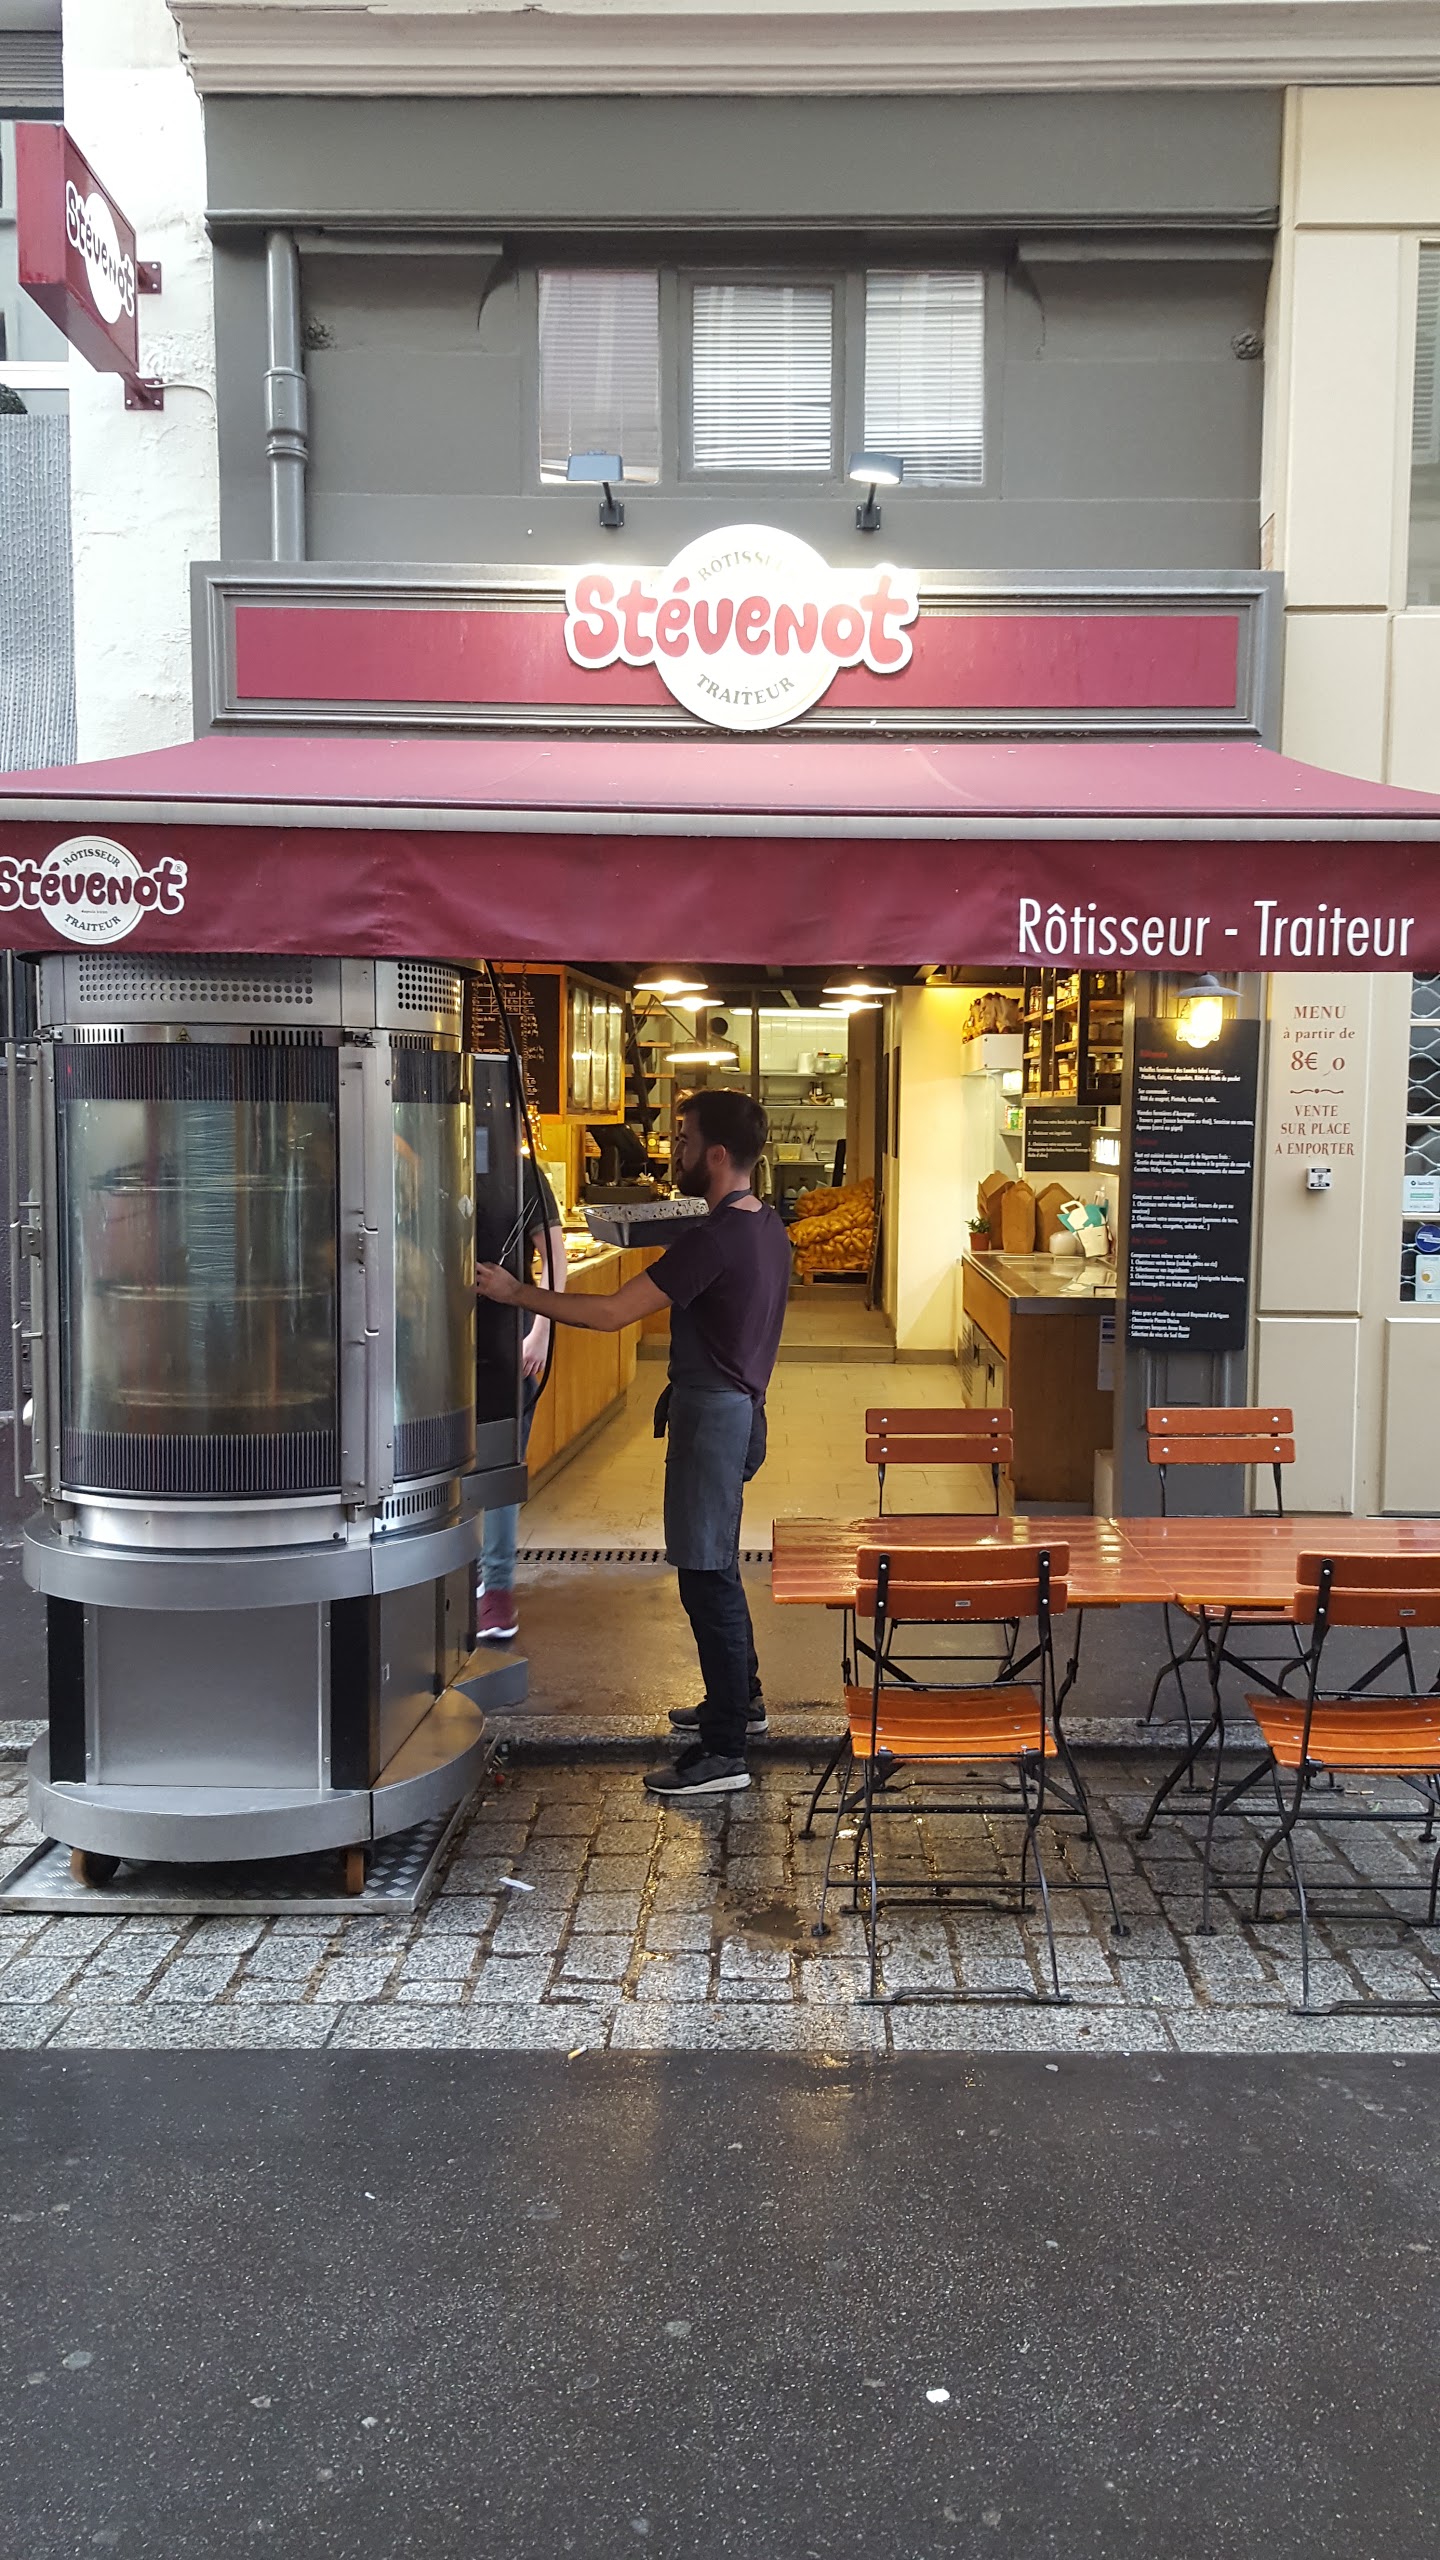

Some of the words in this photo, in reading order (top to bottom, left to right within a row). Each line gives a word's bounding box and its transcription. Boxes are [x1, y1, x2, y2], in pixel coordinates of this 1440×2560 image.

[68, 185, 134, 312] Stévenot
[573, 575, 910, 664] Stévenot
[696, 673, 796, 706] TRAITEUR
[62, 848, 121, 868] RÔTISSEUR
[0, 860, 184, 911] Stévenot
[64, 914, 121, 932] TRAITEUR
[1018, 898, 1210, 957] Rôtisseur
[1253, 900, 1415, 957] Traiteur
[1294, 1006, 1346, 1019] MENU
[1283, 1027, 1290, 1039] à
[1295, 1028, 1335, 1042] partir
[1339, 1028, 1355, 1039] de
[1295, 1105, 1338, 1116] VENTE
[1281, 1123, 1306, 1135] SUR
[1311, 1123, 1350, 1135] PLACE
[1275, 1143, 1282, 1155] A
[1287, 1143, 1355, 1155] EMPORTER
